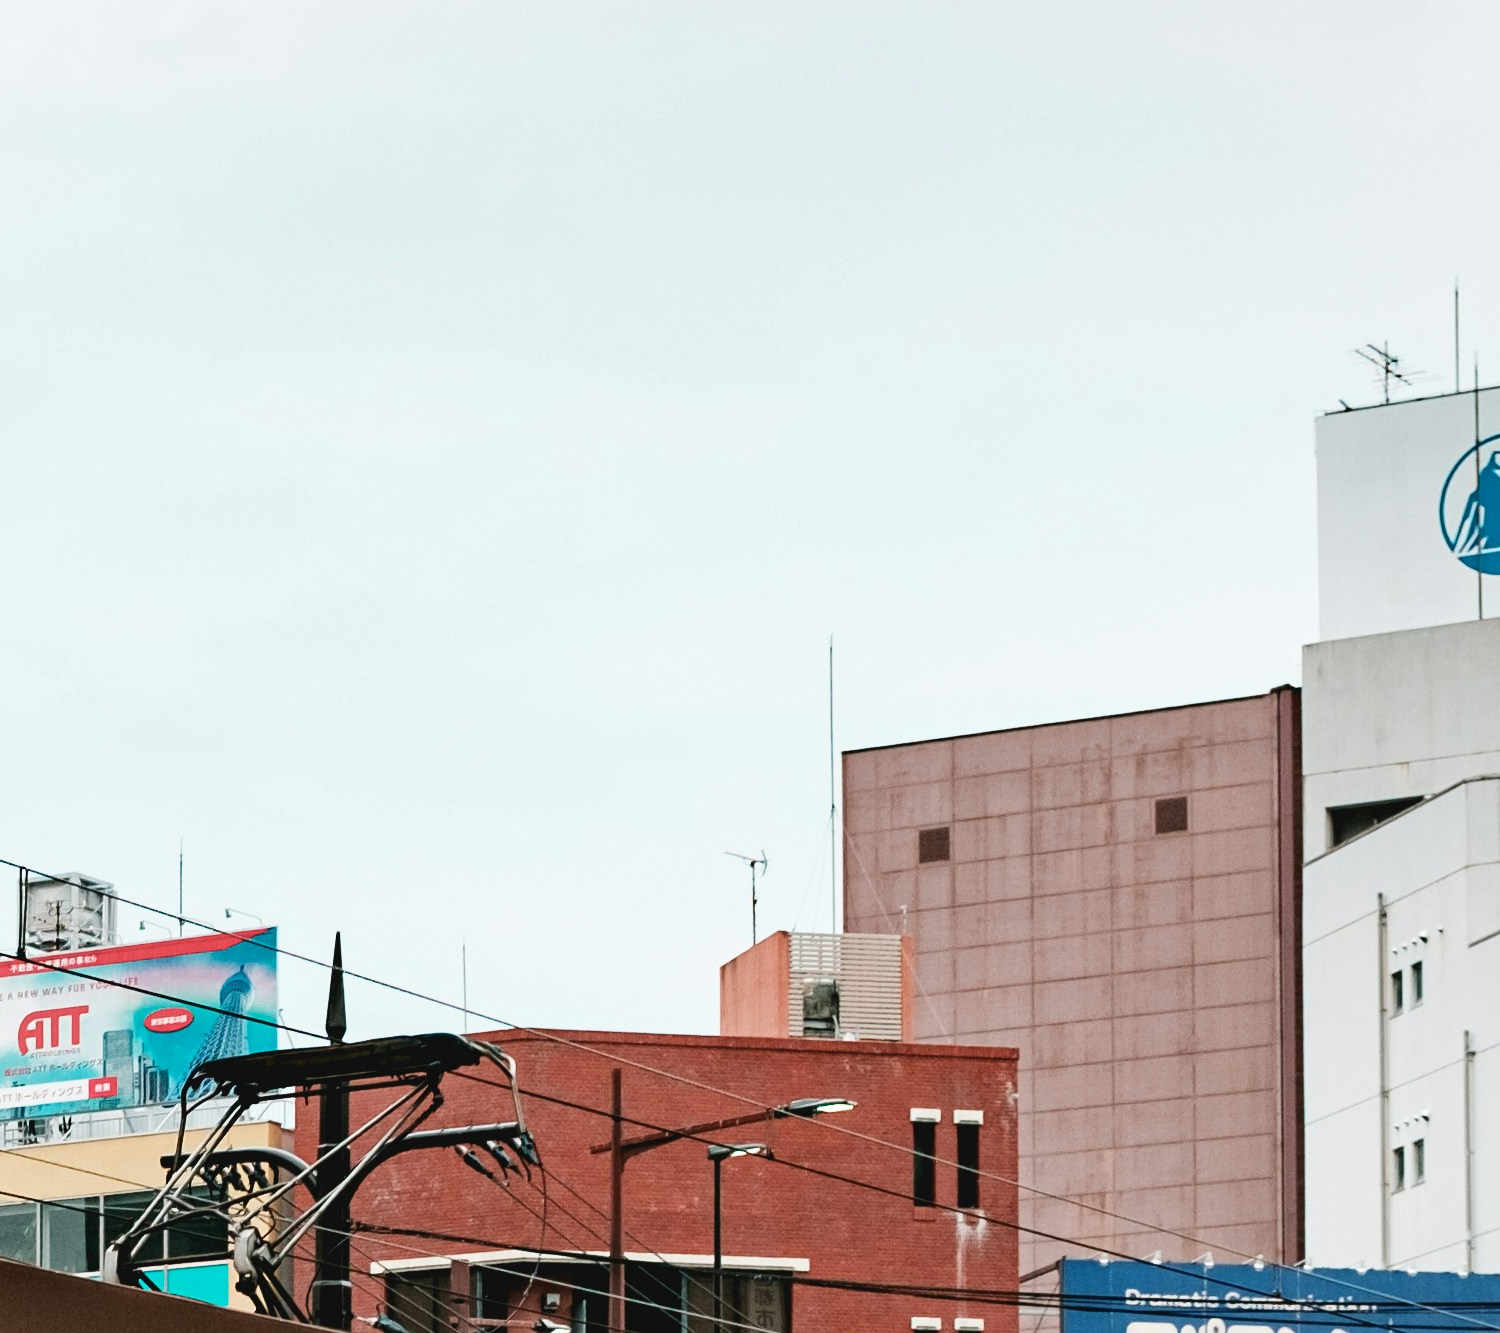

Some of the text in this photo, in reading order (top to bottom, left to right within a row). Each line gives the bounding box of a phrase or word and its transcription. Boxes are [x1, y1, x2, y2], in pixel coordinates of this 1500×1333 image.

[7, 991, 13, 1001] A
[17, 989, 39, 999] NEW
[42, 986, 64, 997] WAY
[68, 984, 86, 994] FOR
[18, 1005, 89, 1056] ATT
[15, 1085, 83, 1101] ホールディングス
[1125, 1288, 1219, 1308] Dramatic
